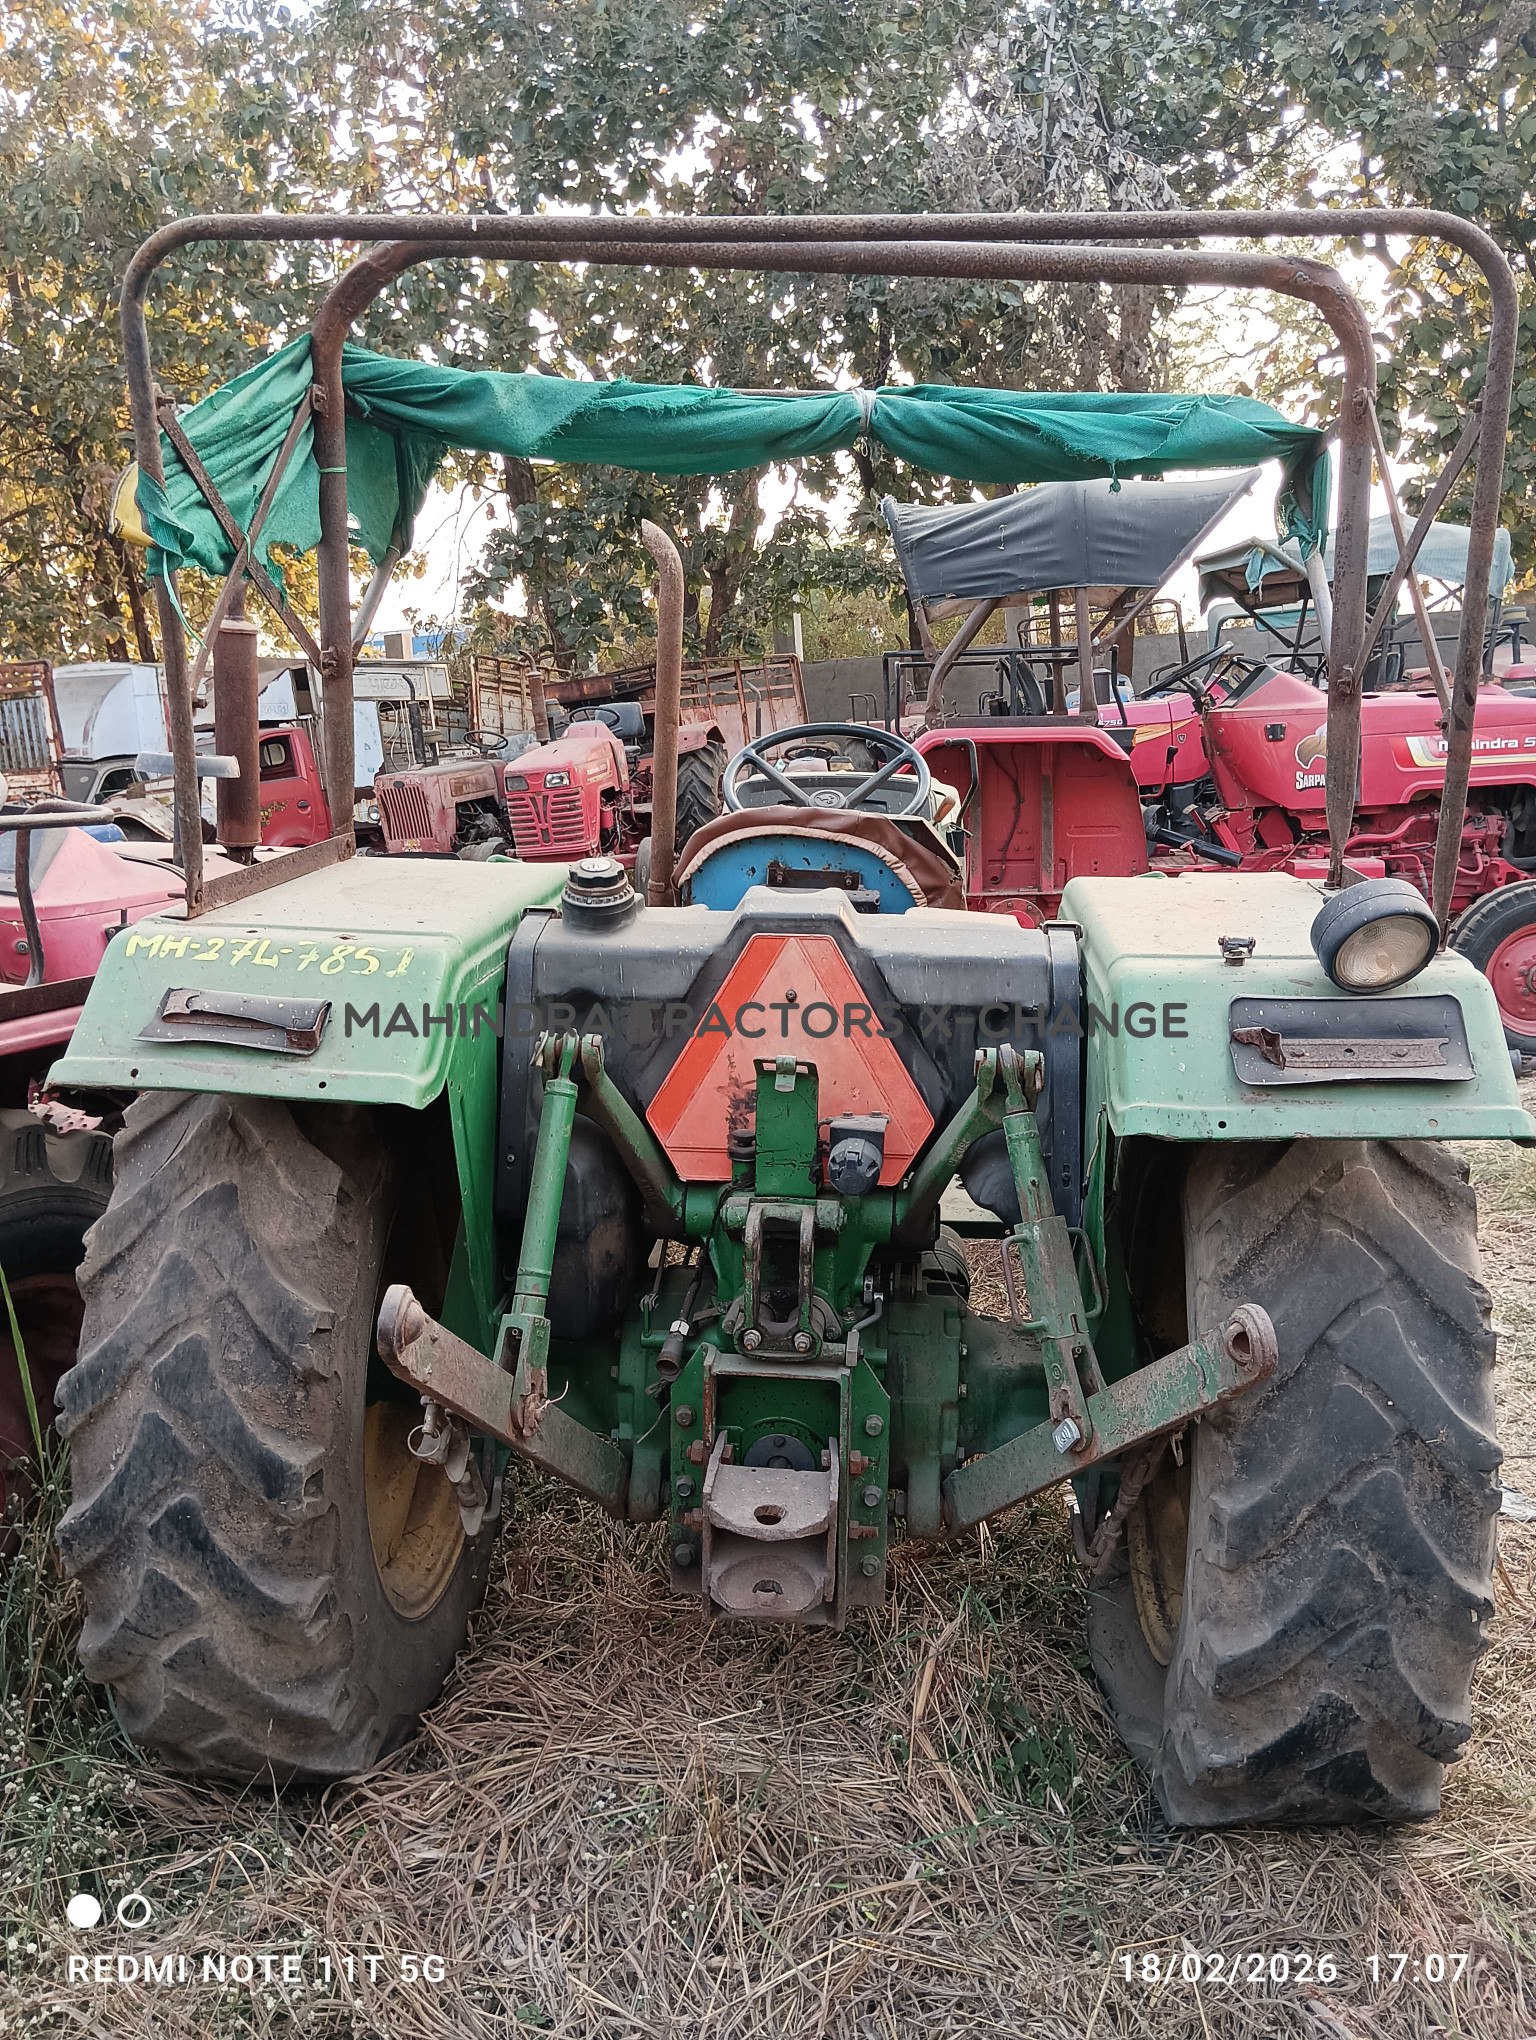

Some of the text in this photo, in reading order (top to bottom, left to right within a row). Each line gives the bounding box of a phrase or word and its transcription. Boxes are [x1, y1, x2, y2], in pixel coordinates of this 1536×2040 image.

[1438, 737, 1536, 752] mindra 5
[1295, 771, 1326, 790] SARPA
